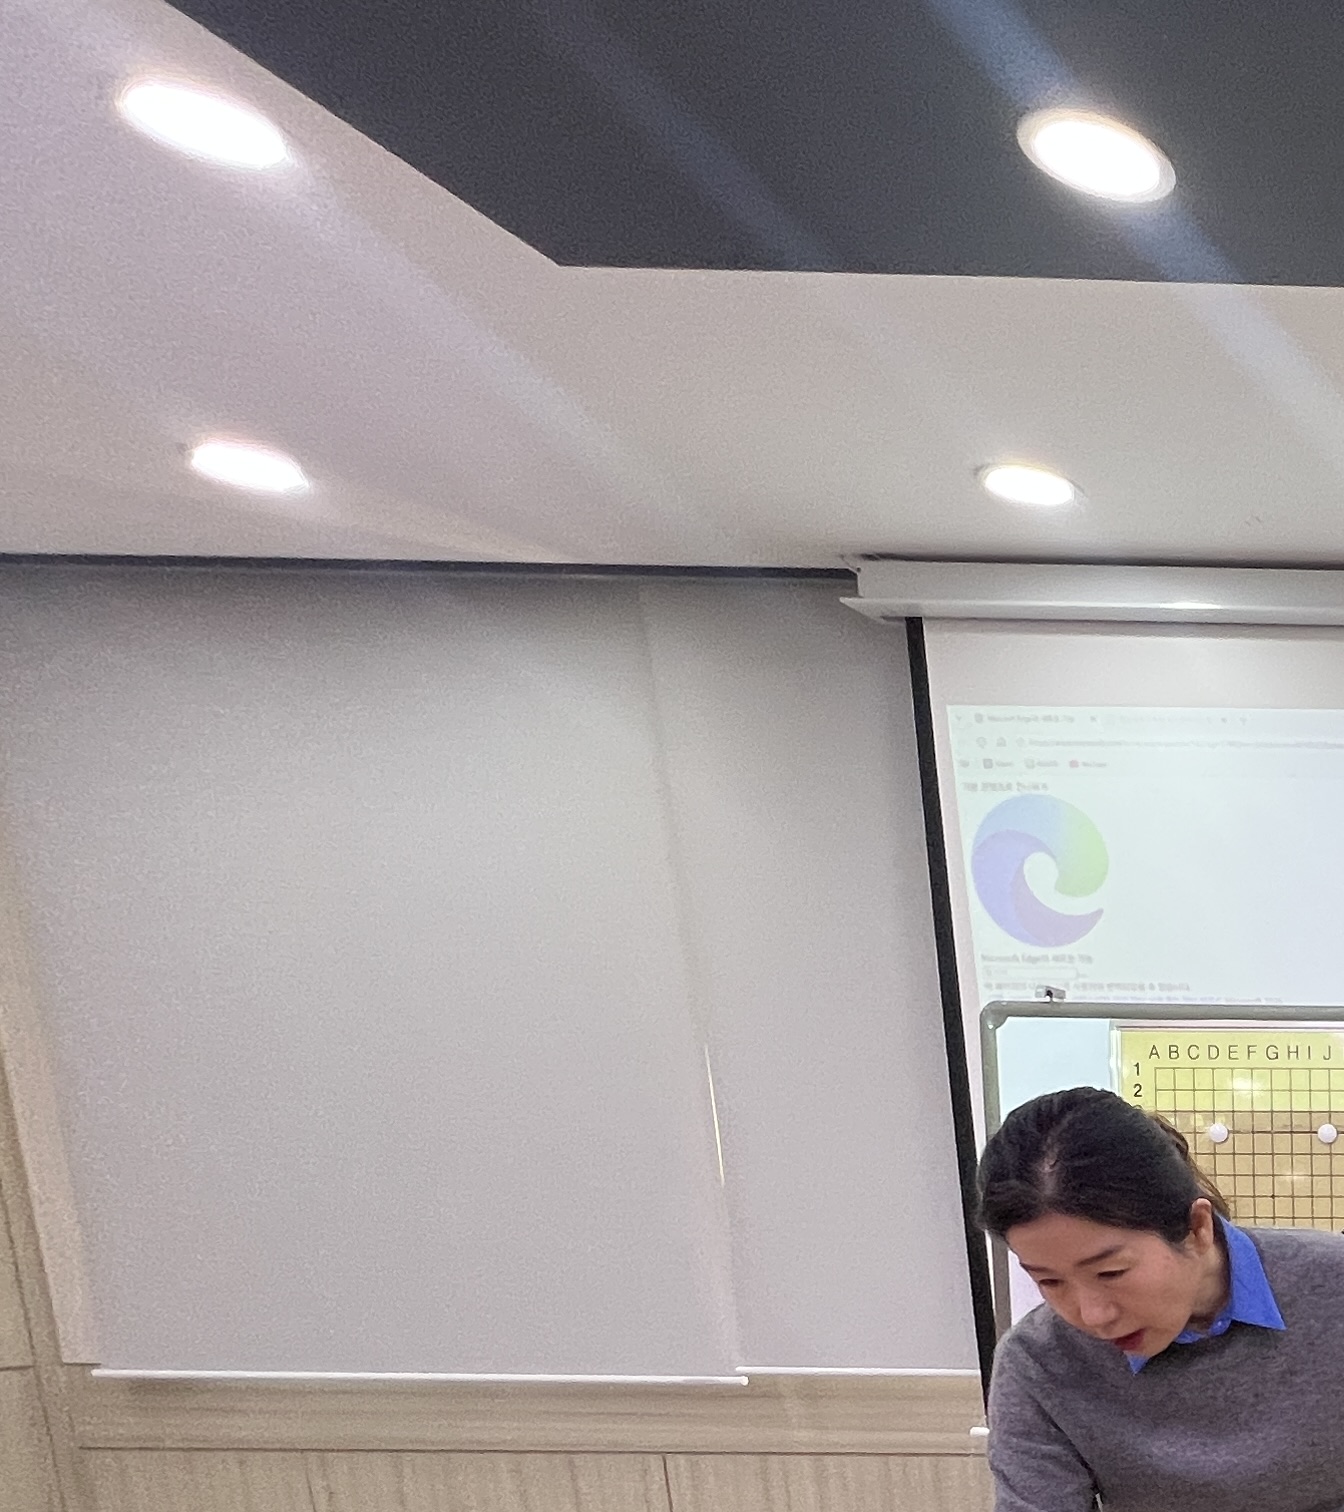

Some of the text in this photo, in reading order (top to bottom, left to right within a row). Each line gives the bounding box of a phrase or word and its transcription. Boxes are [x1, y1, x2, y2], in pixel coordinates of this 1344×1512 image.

[1149, 1045, 1161, 1060] A
[1169, 1045, 1179, 1060] B
[1187, 1044, 1200, 1060] C
[1208, 1045, 1219, 1060] D
[1228, 1045, 1239, 1060] E
[1247, 1045, 1257, 1060] F
[1266, 1045, 1279, 1060] G
[1287, 1044, 1299, 1060] H
[1323, 1045, 1331, 1060] J
[1133, 1062, 1141, 1077] 1
[1132, 1083, 1143, 1098] 2
